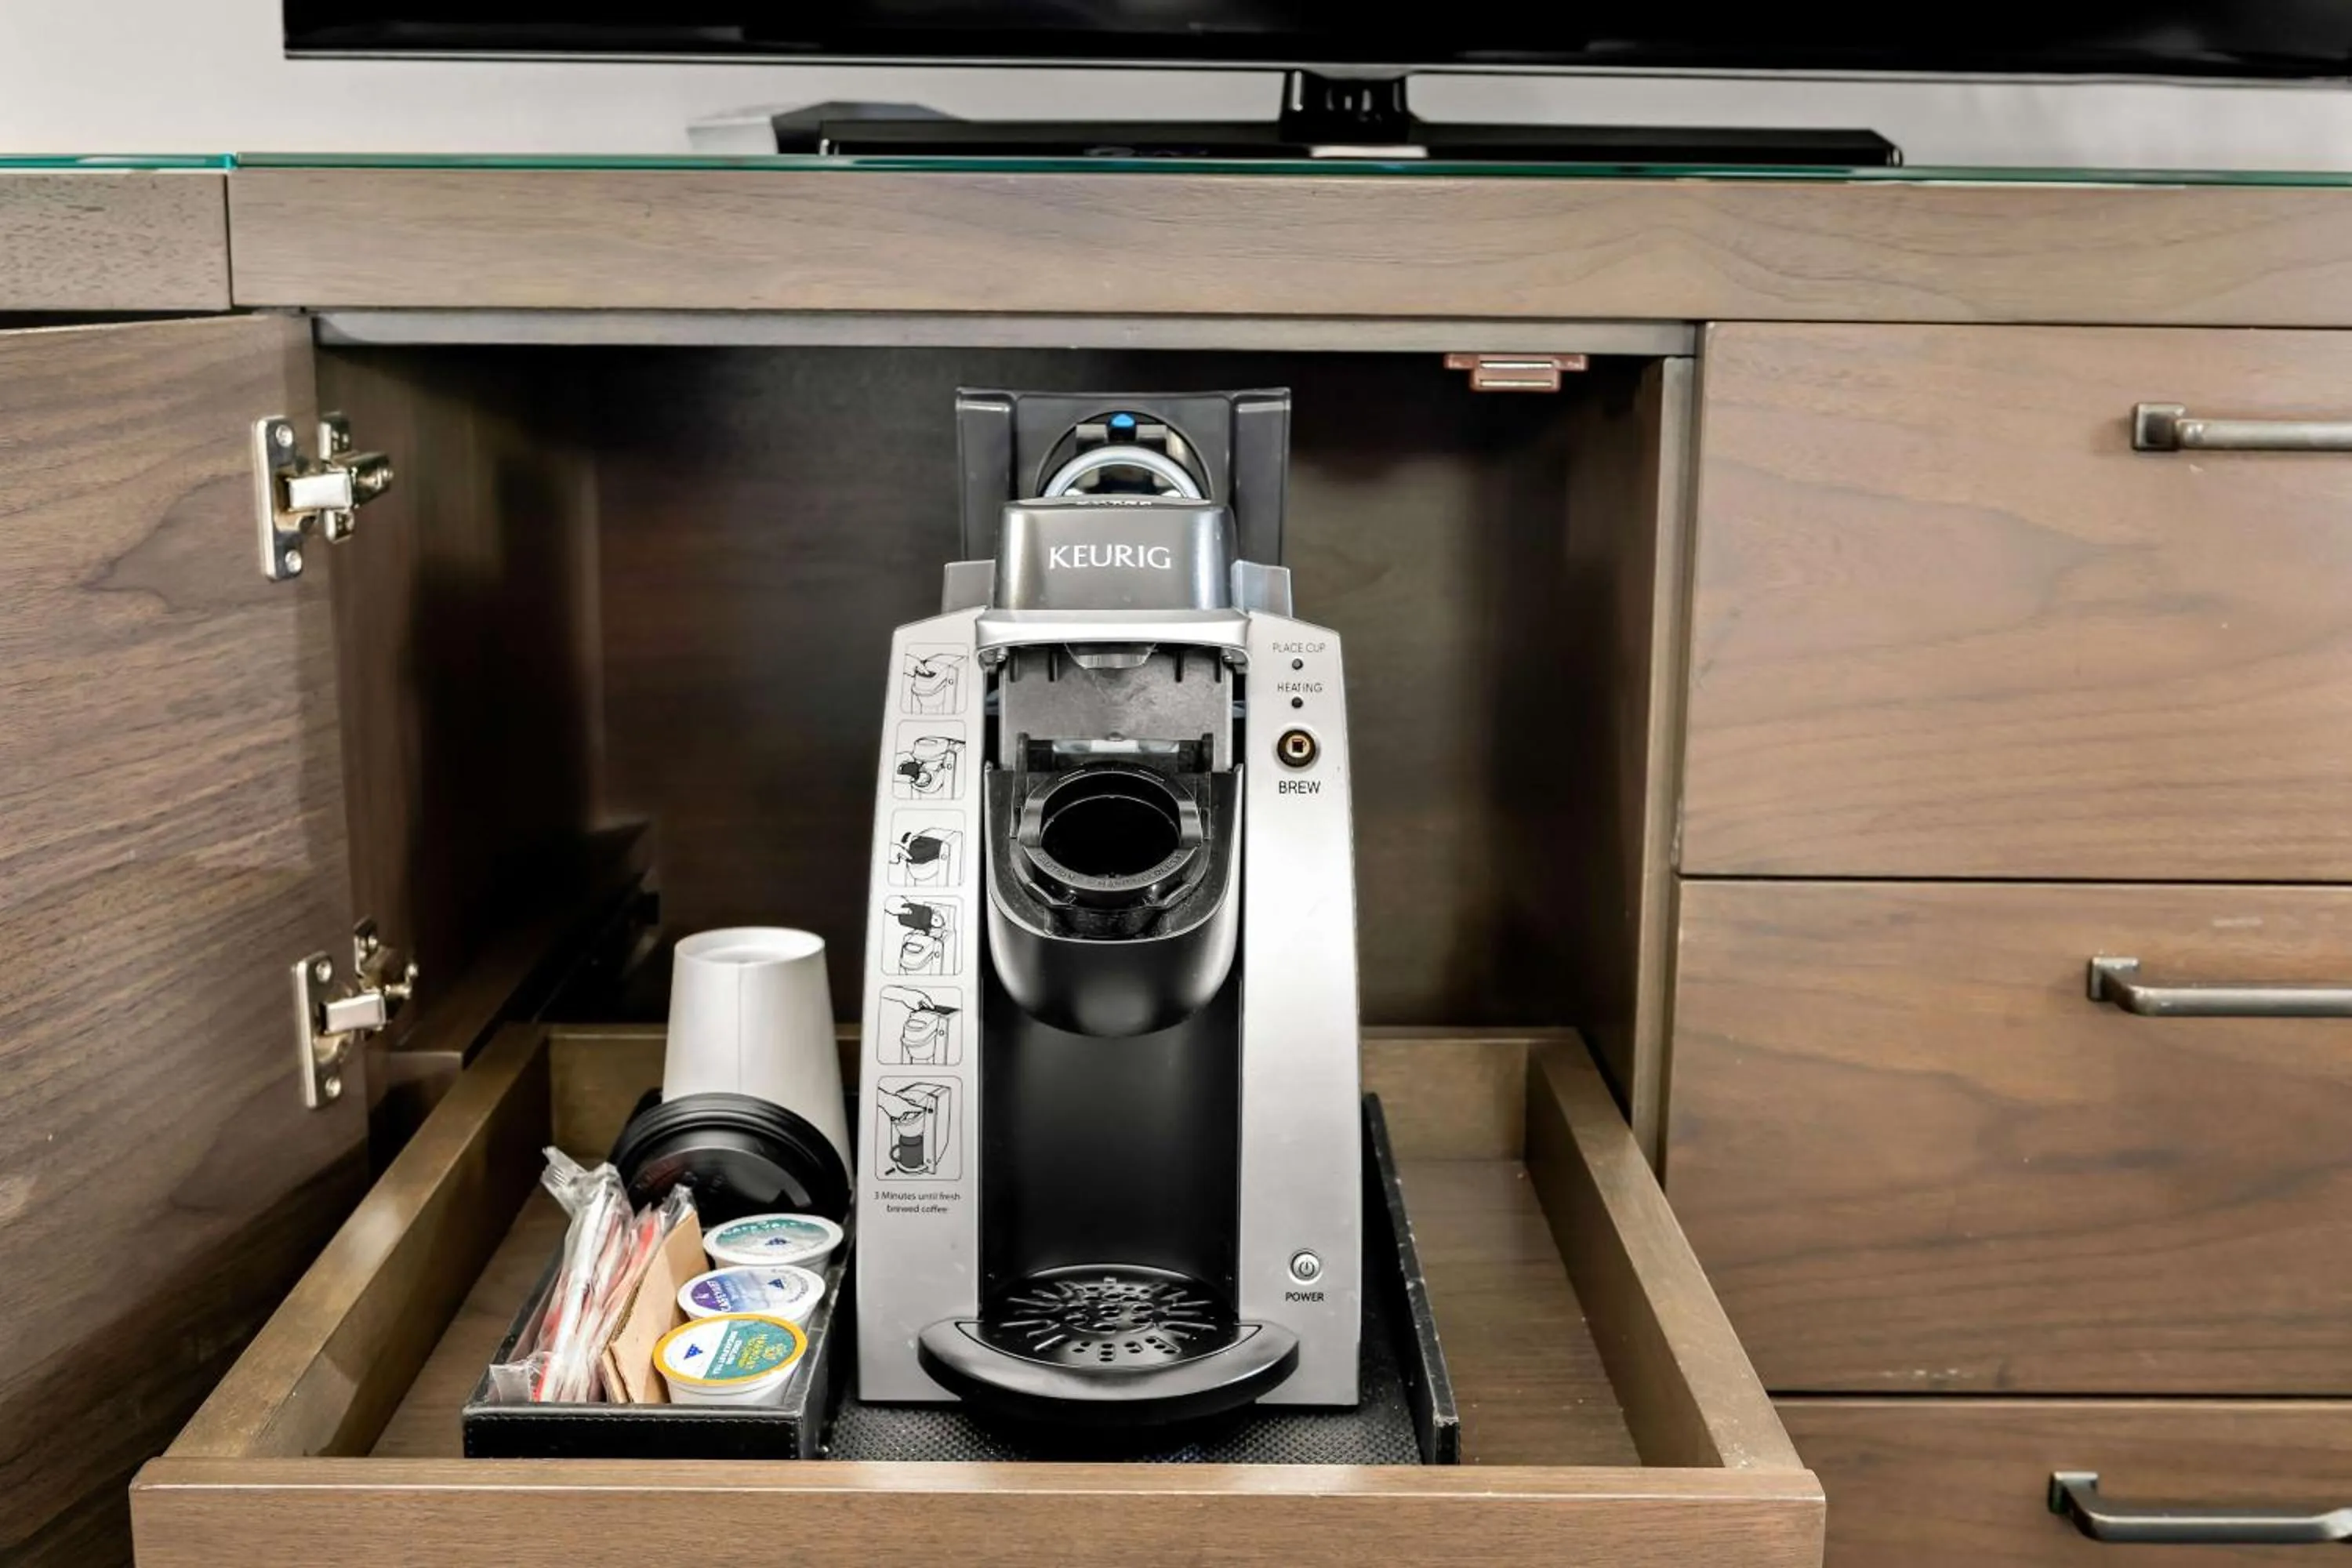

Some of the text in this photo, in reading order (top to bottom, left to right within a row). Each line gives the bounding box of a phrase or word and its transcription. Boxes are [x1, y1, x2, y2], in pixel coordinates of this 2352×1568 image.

[1049, 544, 1171, 569] KEURIG
[1272, 642, 1326, 653] PLACE CUP
[1277, 683, 1323, 693] HEATING
[1279, 780, 1321, 794] BREW
[880, 1191, 916, 1200] Minutes
[918, 1191, 938, 1200] until
[939, 1191, 961, 1200] fresh
[887, 1204, 948, 1213] brewed coffee
[1285, 1291, 1324, 1302] POWER
